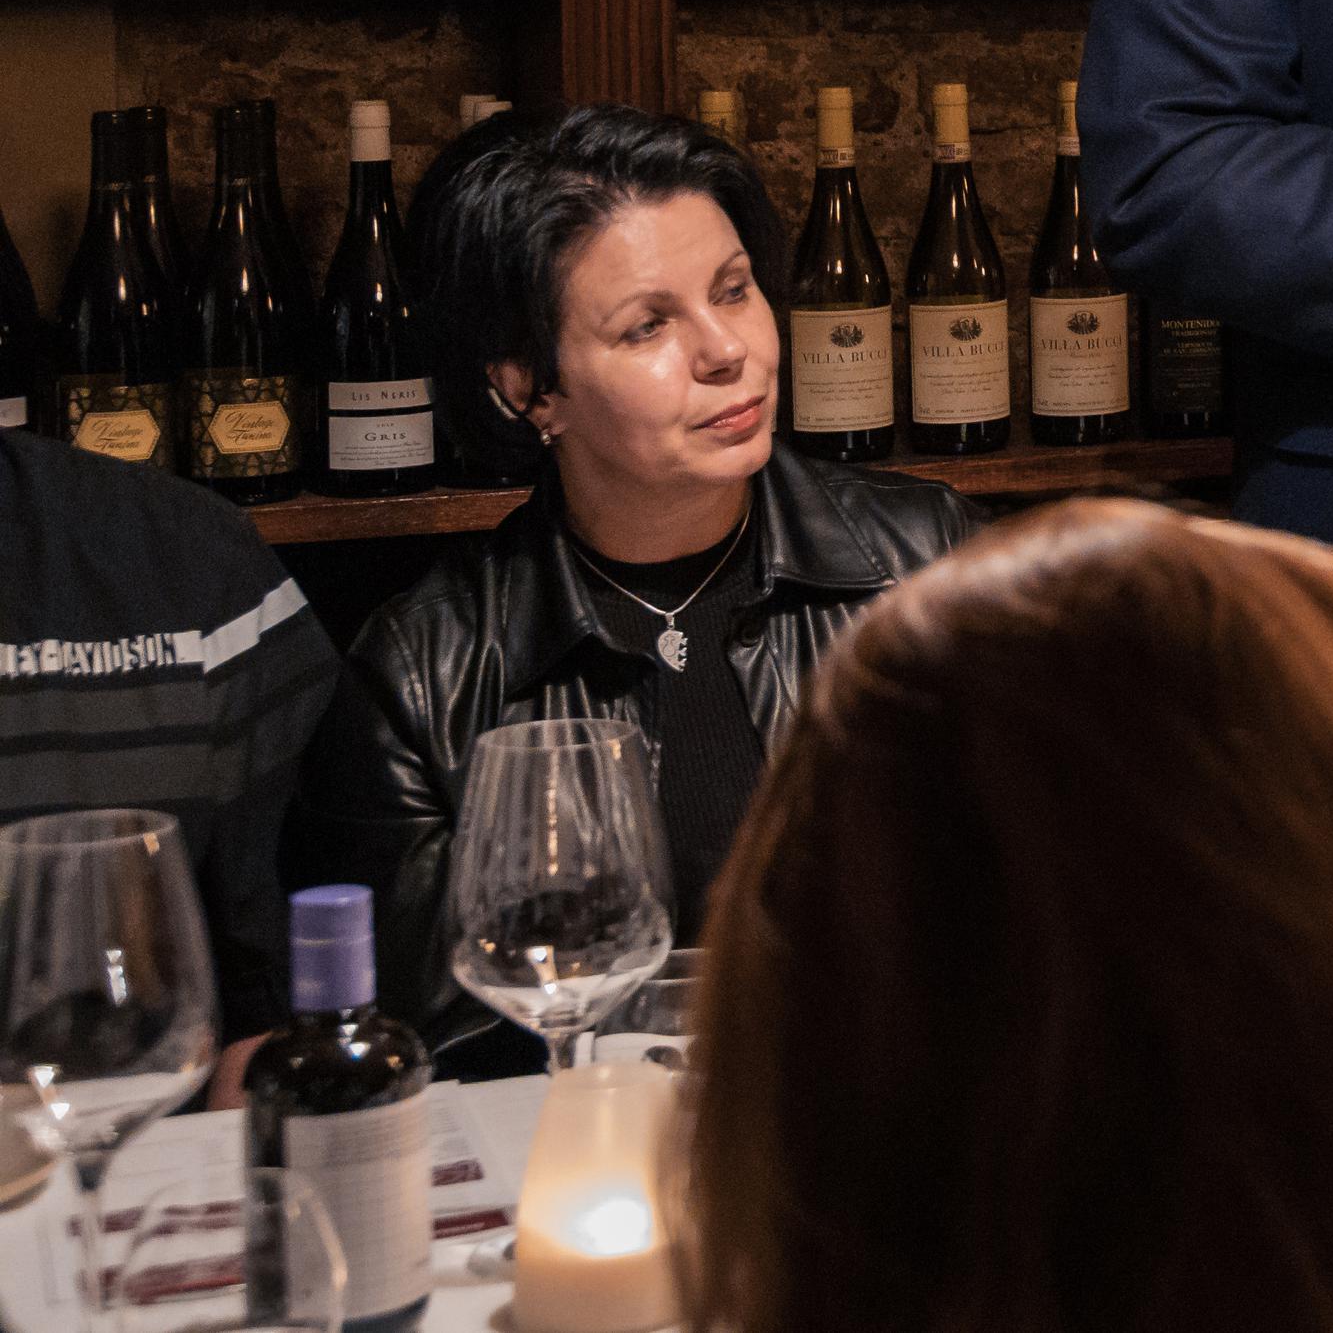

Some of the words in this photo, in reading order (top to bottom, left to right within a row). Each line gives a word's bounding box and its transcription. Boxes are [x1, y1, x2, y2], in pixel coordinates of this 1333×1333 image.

[922, 344, 965, 358] VILLA
[1040, 338, 1082, 352] VILLA
[802, 352, 846, 365] VILLA
[351, 392, 371, 402] LIS
[380, 390, 417, 400] NERIS
[224, 411, 274, 438] Vintage
[364, 431, 408, 443] GRIS
